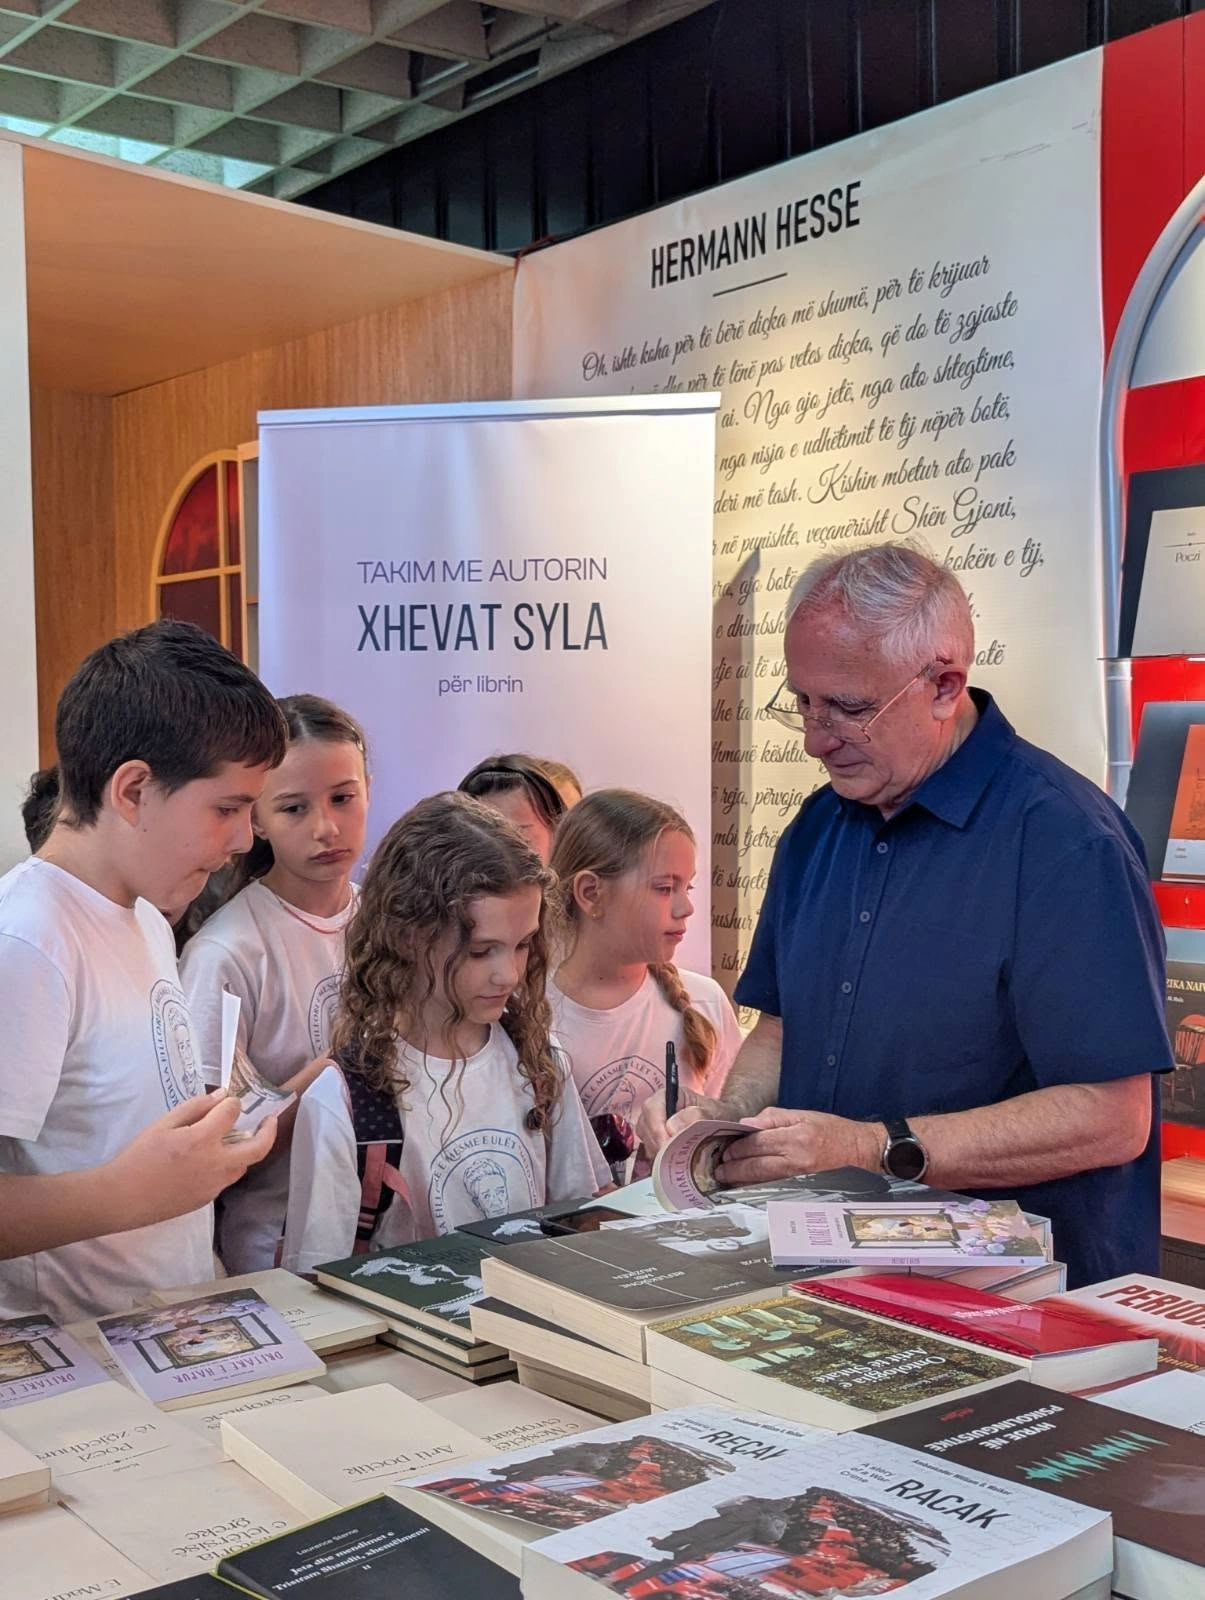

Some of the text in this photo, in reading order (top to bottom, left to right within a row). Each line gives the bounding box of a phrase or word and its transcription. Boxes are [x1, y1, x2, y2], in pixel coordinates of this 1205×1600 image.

[650, 180, 862, 289] HERMANN HESSE
[612, 346, 638, 373] ishte
[640, 337, 669, 364] koha
[672, 334, 695, 365] për
[699, 325, 712, 349] të
[716, 319, 744, 344] bërë
[748, 306, 786, 340] diçka
[791, 301, 814, 326] më
[818, 290, 869, 318] shumë,
[872, 278, 902, 314] për
[908, 268, 925, 294] të
[928, 254, 990, 299] krijuar
[712, 364, 726, 388] të
[757, 353, 784, 387] pas
[790, 342, 824, 370] vetes
[827, 329, 873, 365] diçka,
[905, 313, 928, 343] do
[934, 309, 951, 336] të
[949, 290, 1019, 344] zgjaste
[743, 389, 790, 429] Nga
[816, 378, 855, 420] jetë,
[860, 378, 894, 410] nga
[900, 362, 928, 391] ato
[933, 346, 1015, 391] shtegtime,
[718, 392, 1011, 481] nga nisja e udhëtimit të tij nëpër botë,
[713, 439, 1016, 514] deri më tash. Kishin mbetur ato pak
[721, 537, 738, 556] në
[806, 513, 890, 549] veçanërisht
[891, 495, 947, 535] Shën
[950, 486, 1017, 538] Gjoni,
[357, 557, 608, 584] TAKIM ME AUTORIN
[1004, 549, 1015, 566] e
[357, 602, 608, 652] XHEVAT SYLA
[726, 610, 787, 639] dhimbsh
[735, 662, 751, 680] ai
[753, 655, 770, 679] të
[771, 659, 787, 678] sh
[975, 639, 1006, 667] otë
[438, 675, 524, 697] për librin
[737, 825, 778, 857] tjetrë
[727, 868, 770, 897] shqetë
[721, 952, 746, 971] isht
[33, 1428, 131, 1463] zgjedhur
[924, 1404, 1064, 1453] PSIKOLINGUISTIKË
[979, 1422, 1056, 1451] HYRJE NË
[884, 1478, 1009, 1530] RACAK
[313, 1554, 334, 1567] dhe
[335, 1534, 387, 1559] mendimet
